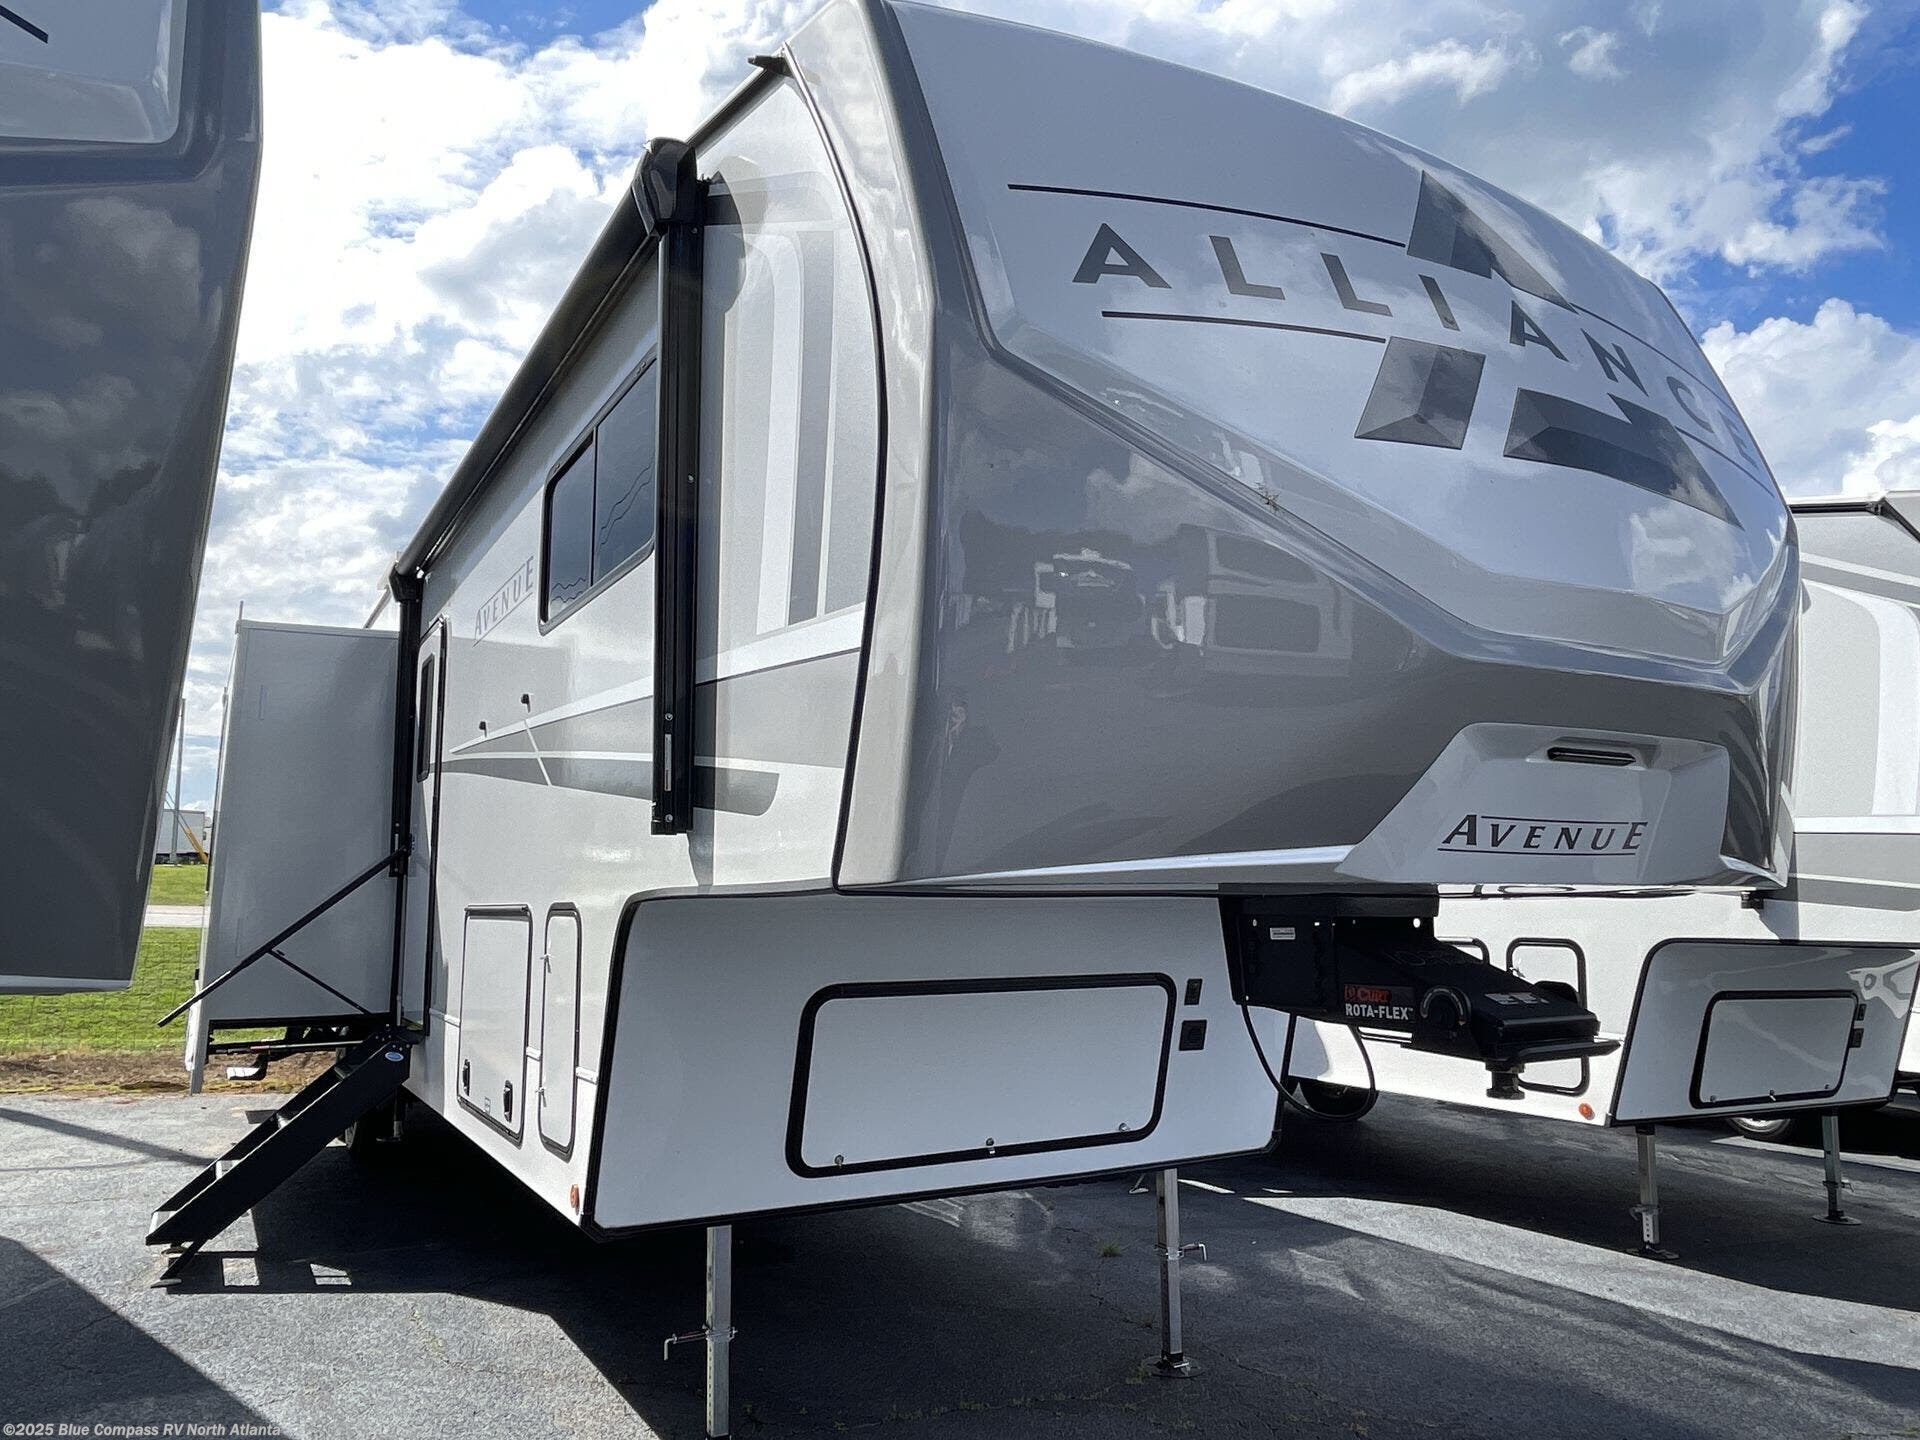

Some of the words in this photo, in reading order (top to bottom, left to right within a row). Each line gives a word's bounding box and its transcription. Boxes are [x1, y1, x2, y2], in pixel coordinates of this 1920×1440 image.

[1072, 222, 1759, 471] ALLIANCE
[474, 555, 534, 640] AVENUE
[1441, 814, 1648, 851] AVENUE
